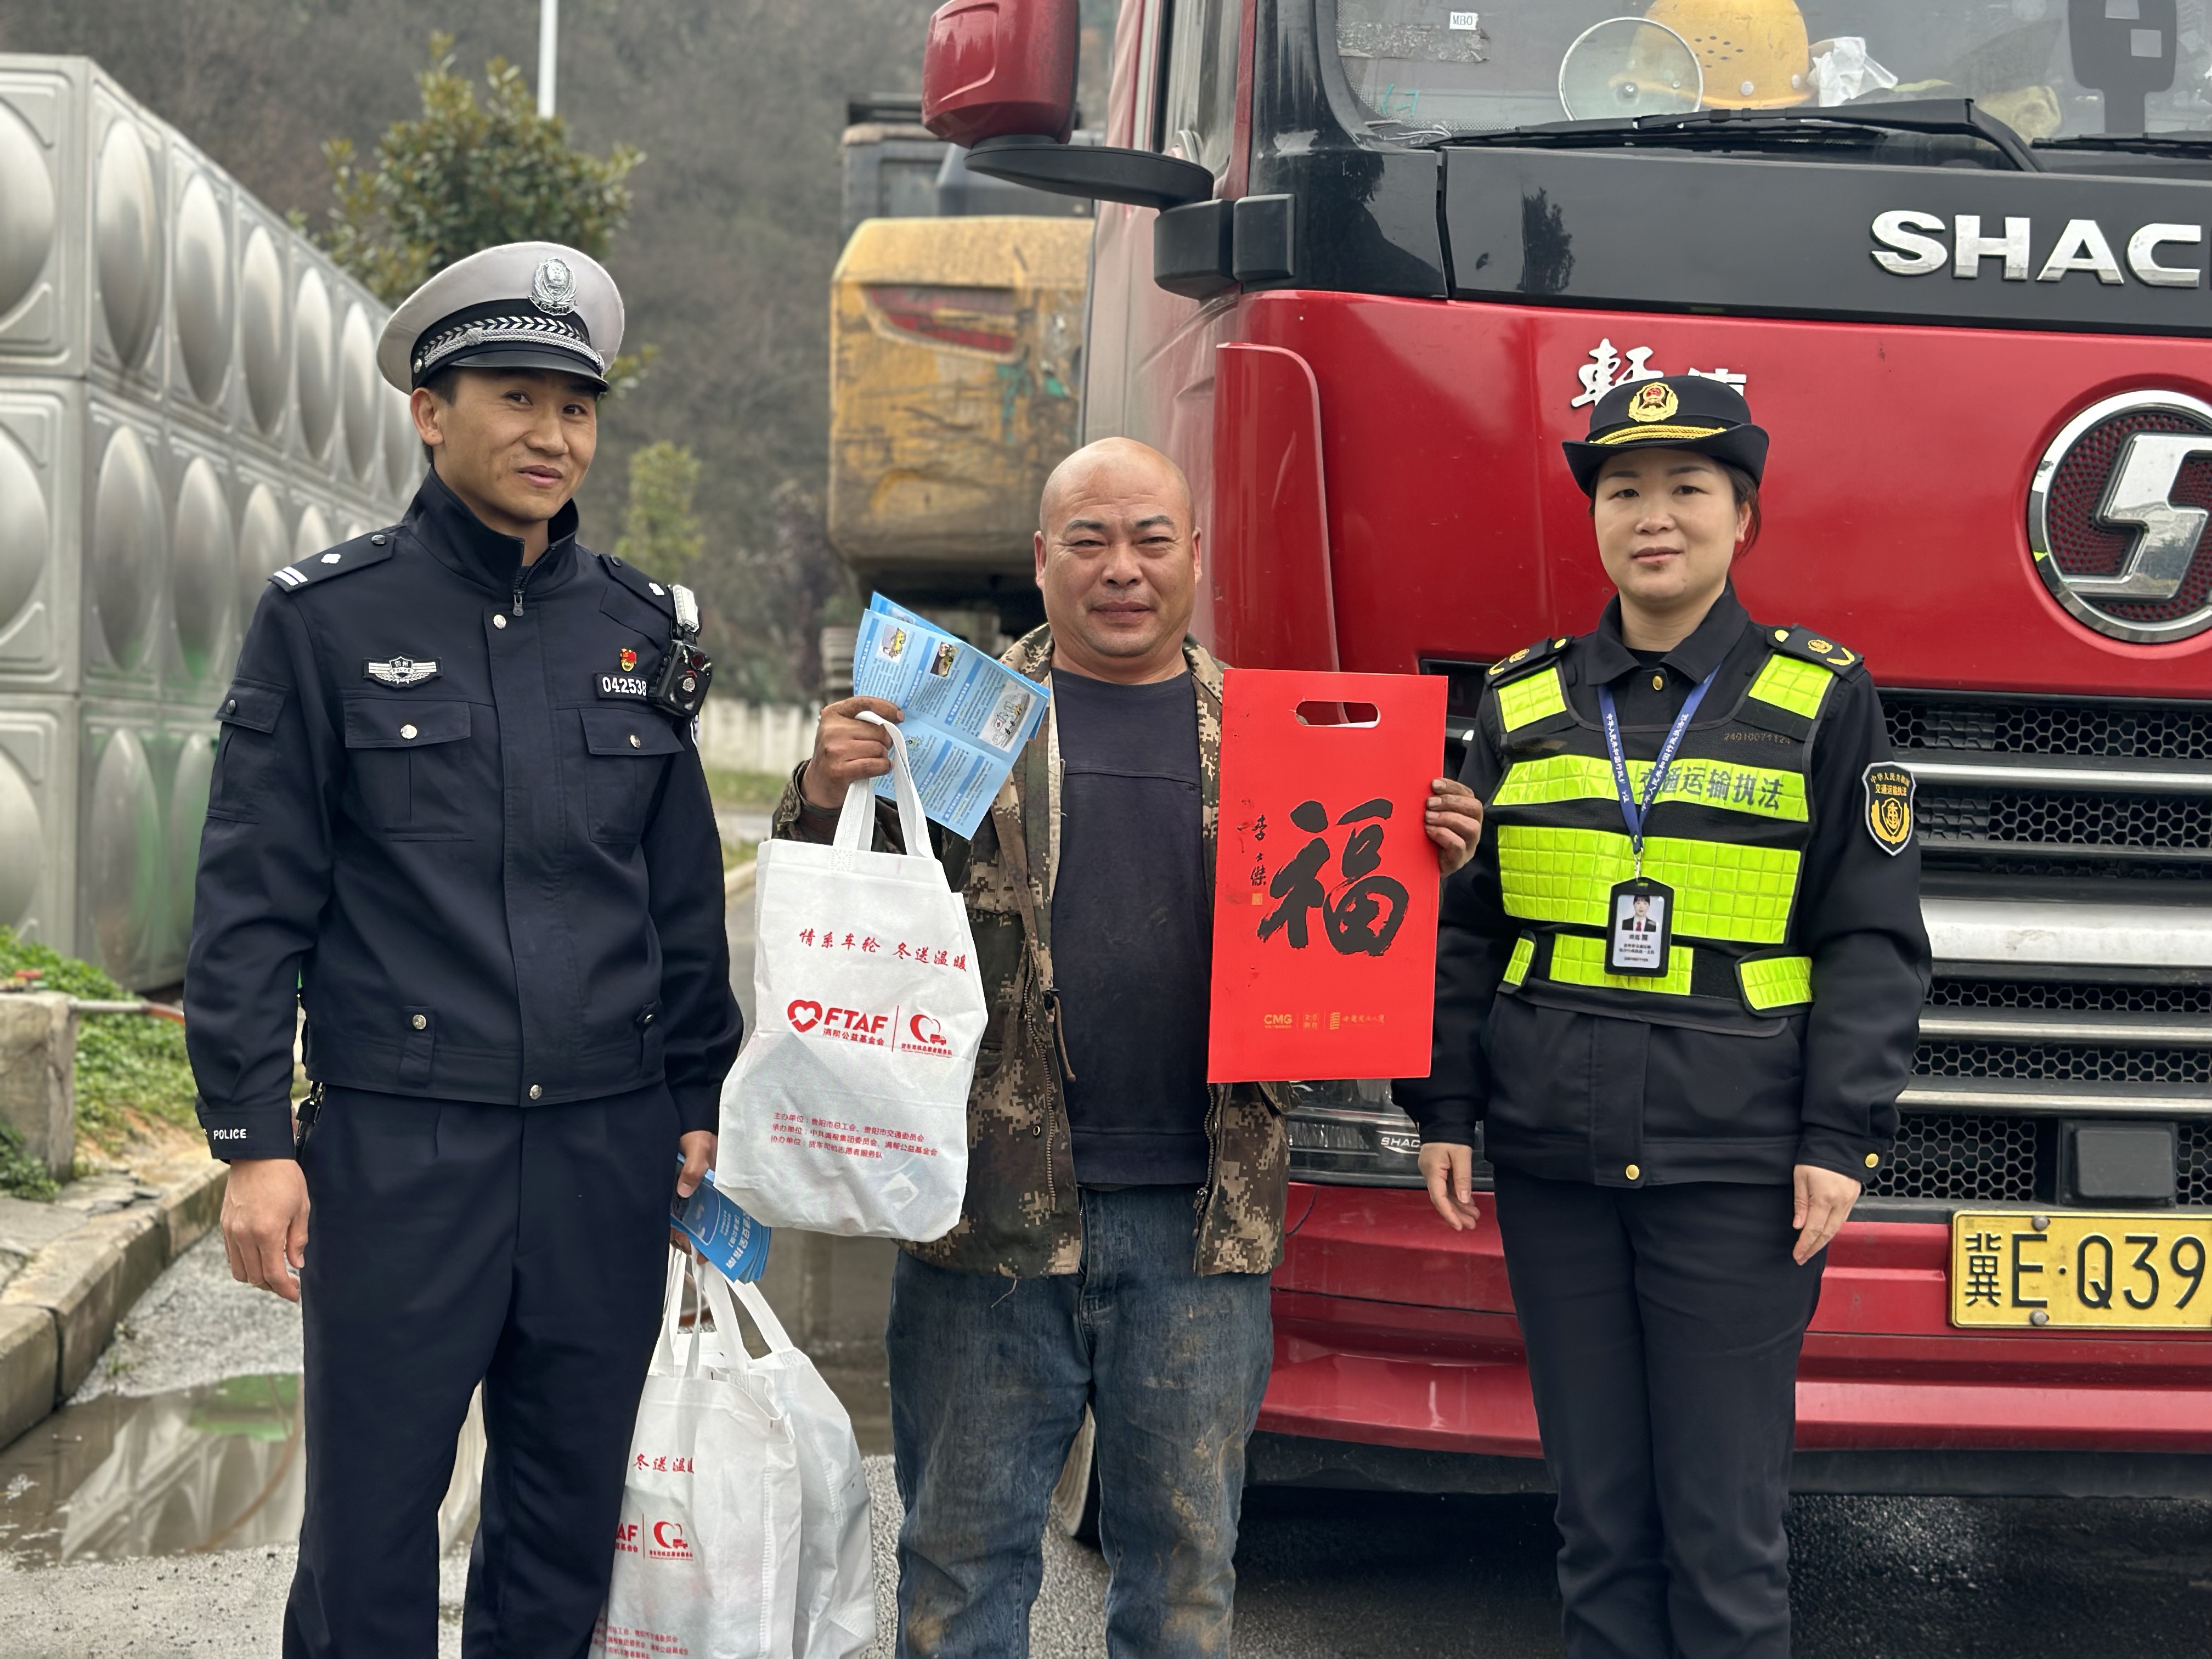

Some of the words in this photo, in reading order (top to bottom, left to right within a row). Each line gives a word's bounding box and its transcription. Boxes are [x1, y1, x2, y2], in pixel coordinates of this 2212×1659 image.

[1871, 210, 2202, 287] SHAC
[602, 676, 647, 696] 042538
[1605, 713, 1630, 805] 中华人民共和国行政证
[1257, 798, 1410, 956] 福
[799, 928, 881, 953] 情系车轮
[892, 941, 967, 972] 冬送温暖
[823, 1007, 889, 1034] FTAF
[1263, 1014, 1293, 1024] CMG
[213, 1128, 247, 1140] POLICE
[1380, 1137, 1421, 1148] SHAC
